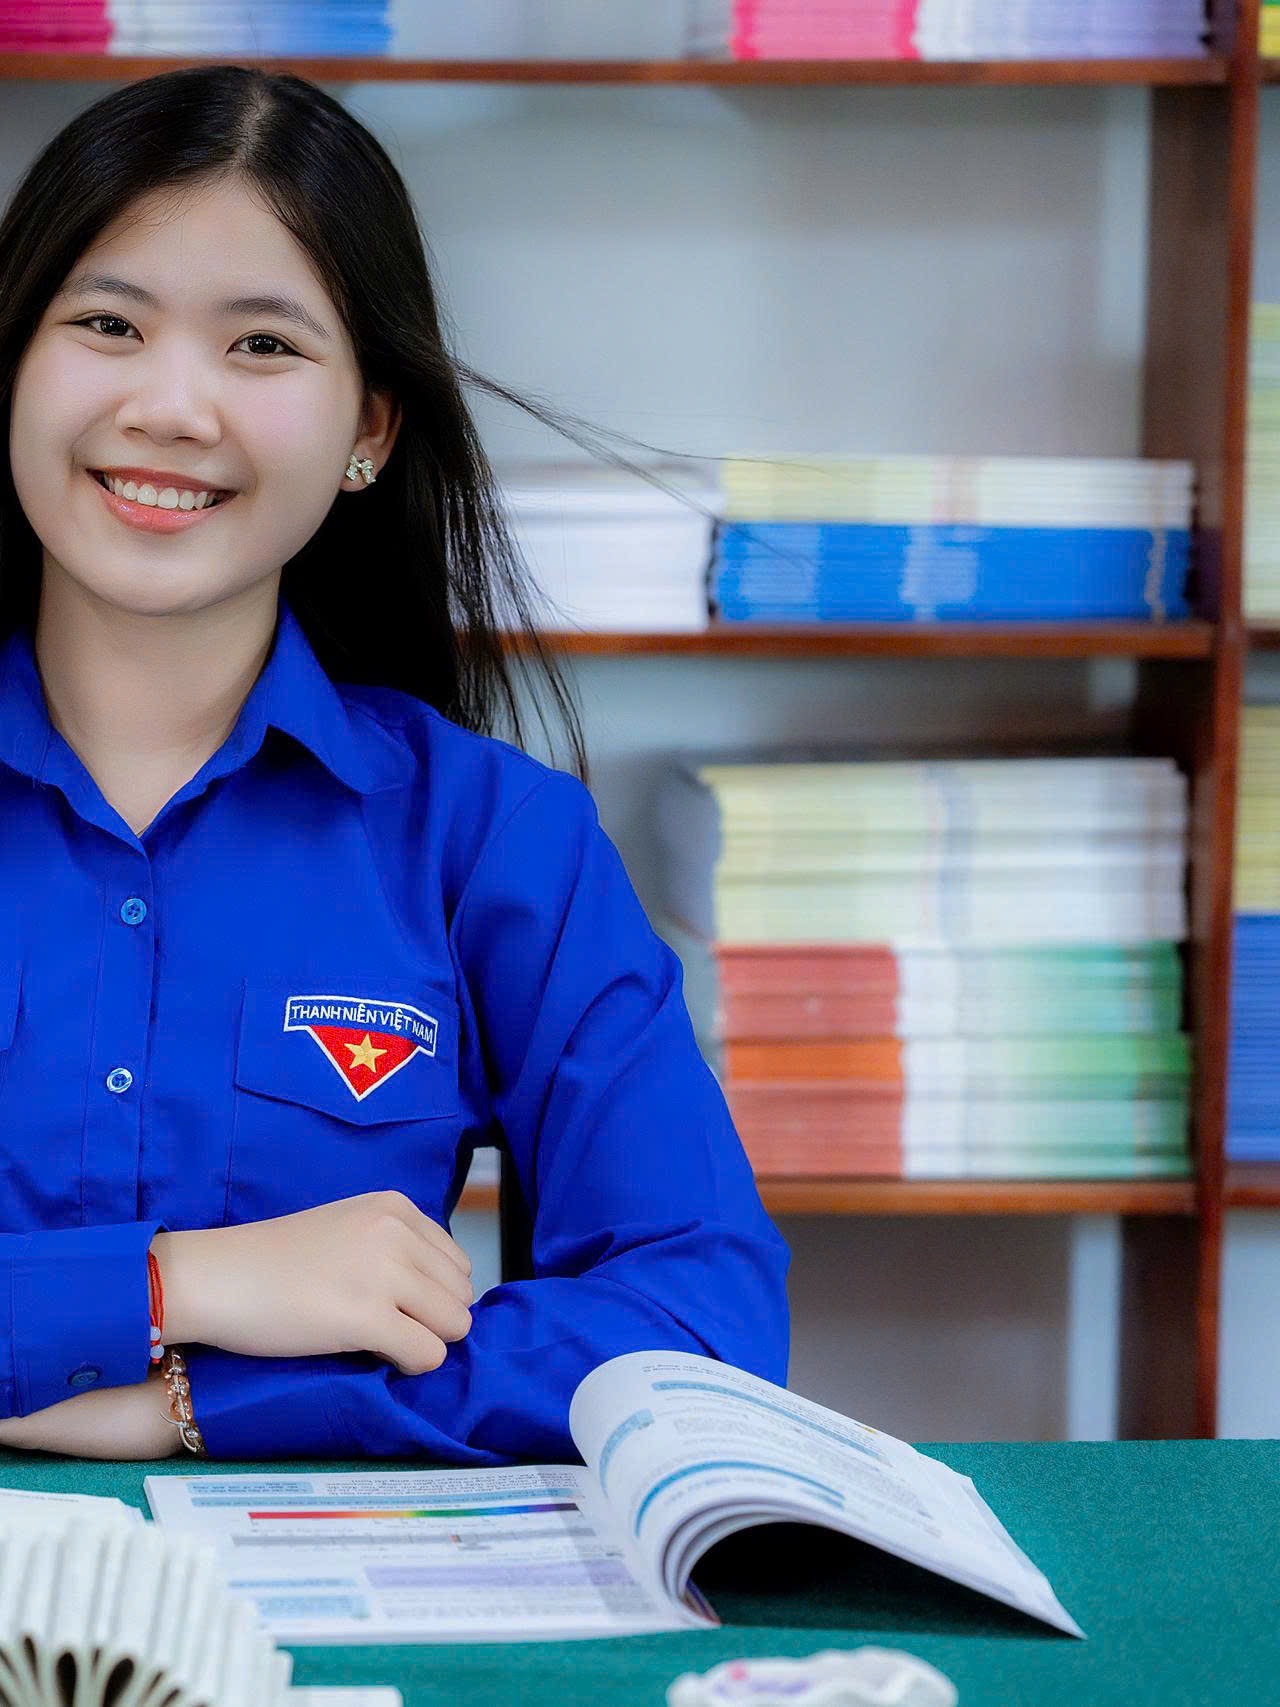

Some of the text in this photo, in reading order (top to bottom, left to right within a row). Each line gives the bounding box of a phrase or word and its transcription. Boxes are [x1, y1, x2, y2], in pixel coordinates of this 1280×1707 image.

[291, 1003, 433, 1044] THANH NIÊN VIỆT NAM
